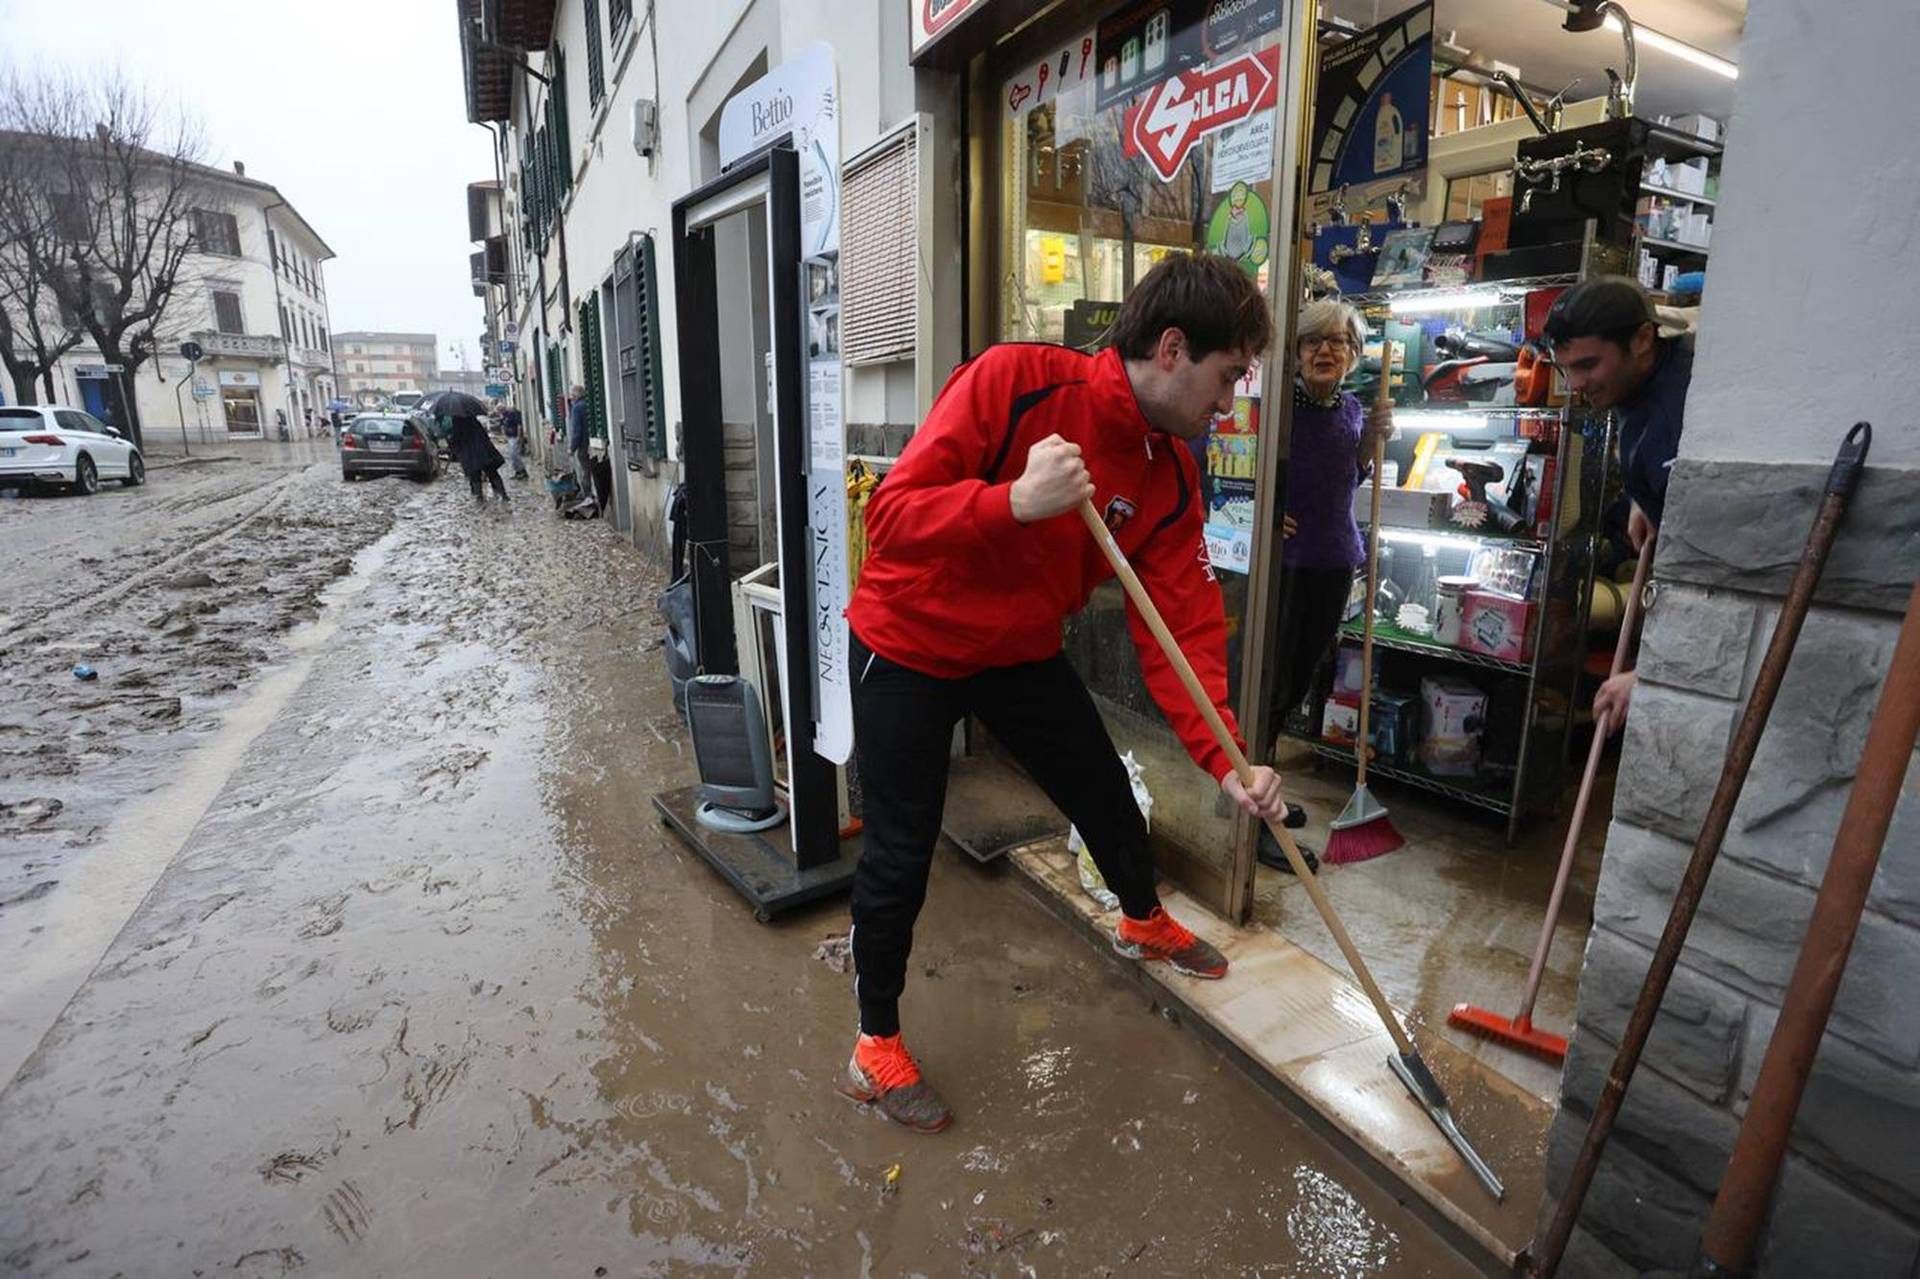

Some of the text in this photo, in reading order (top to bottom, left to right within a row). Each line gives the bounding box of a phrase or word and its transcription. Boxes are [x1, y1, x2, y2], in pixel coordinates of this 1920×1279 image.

[752, 87, 793, 137] Bettio
[1144, 72, 1249, 161] SILCA
[1250, 122, 1270, 136] AREA
[815, 484, 833, 682] NEOSCENICA
